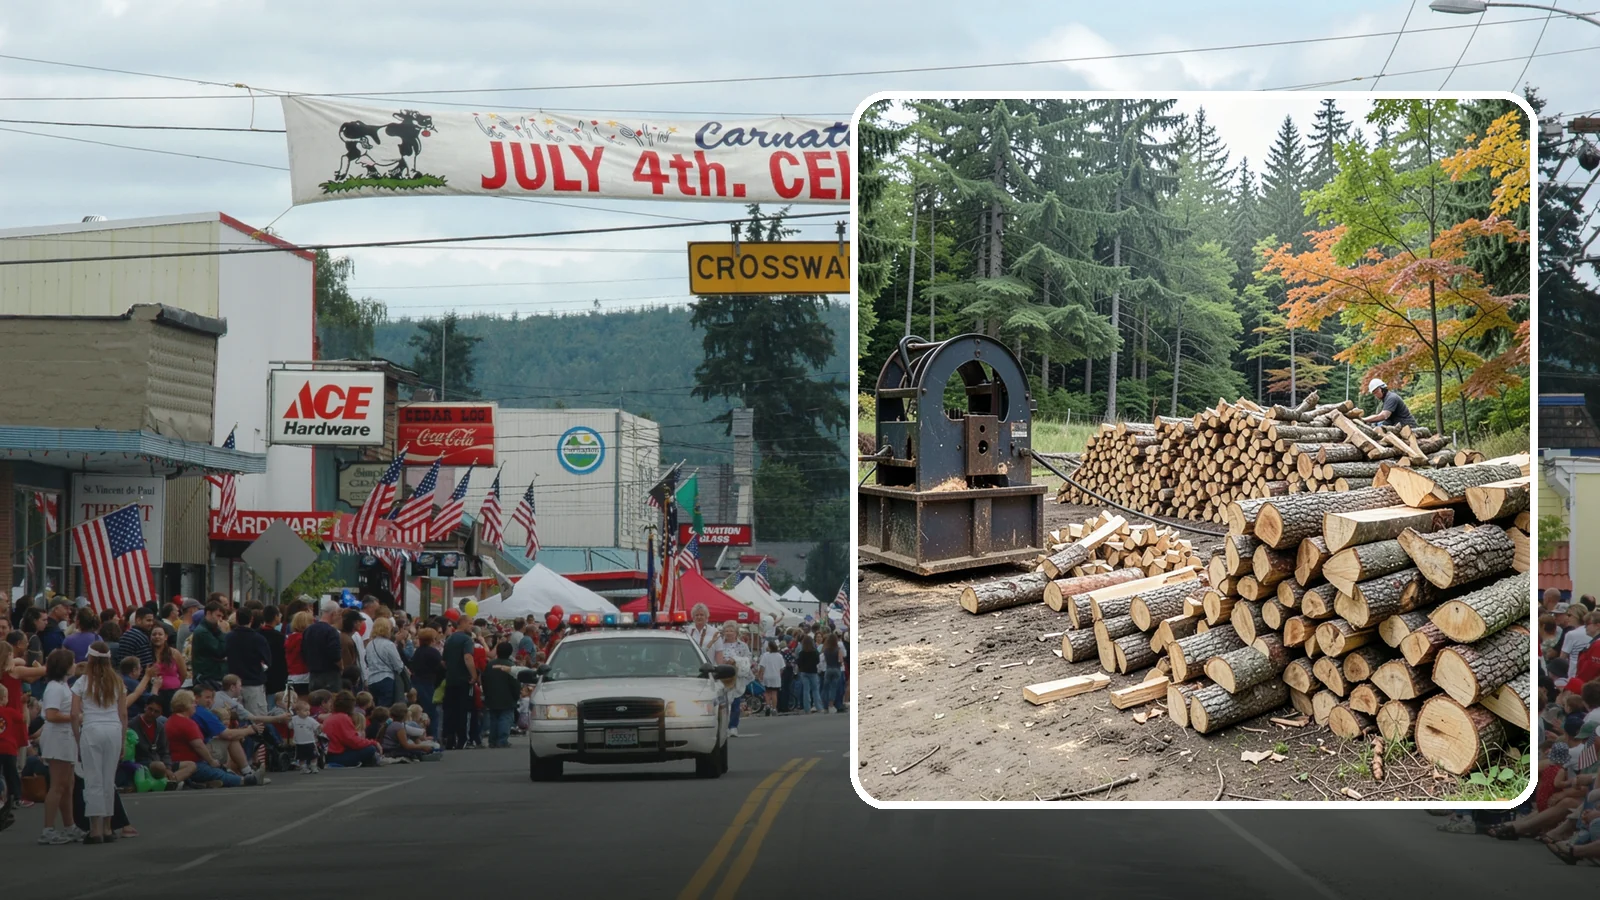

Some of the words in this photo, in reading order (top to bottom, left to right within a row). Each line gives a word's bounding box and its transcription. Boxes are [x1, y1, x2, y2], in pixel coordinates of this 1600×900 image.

[481, 141, 605, 192] JULY
[632, 150, 747, 198] 4th.
[696, 254, 850, 280] CROSSWA
[282, 380, 374, 420] ACE
[406, 410, 453, 422] CEDAR
[461, 410, 485, 422] LOG
[283, 421, 371, 437] Hardware
[416, 427, 477, 448] Coca-Cola
[353, 467, 387, 481] Simpl
[83, 484, 94, 494] St.
[95, 485, 124, 495] Vincent
[126, 486, 136, 495] de
[137, 486, 155, 495] Paul
[688, 526, 741, 535] CRNATION
[699, 535, 730, 544] GLASS
